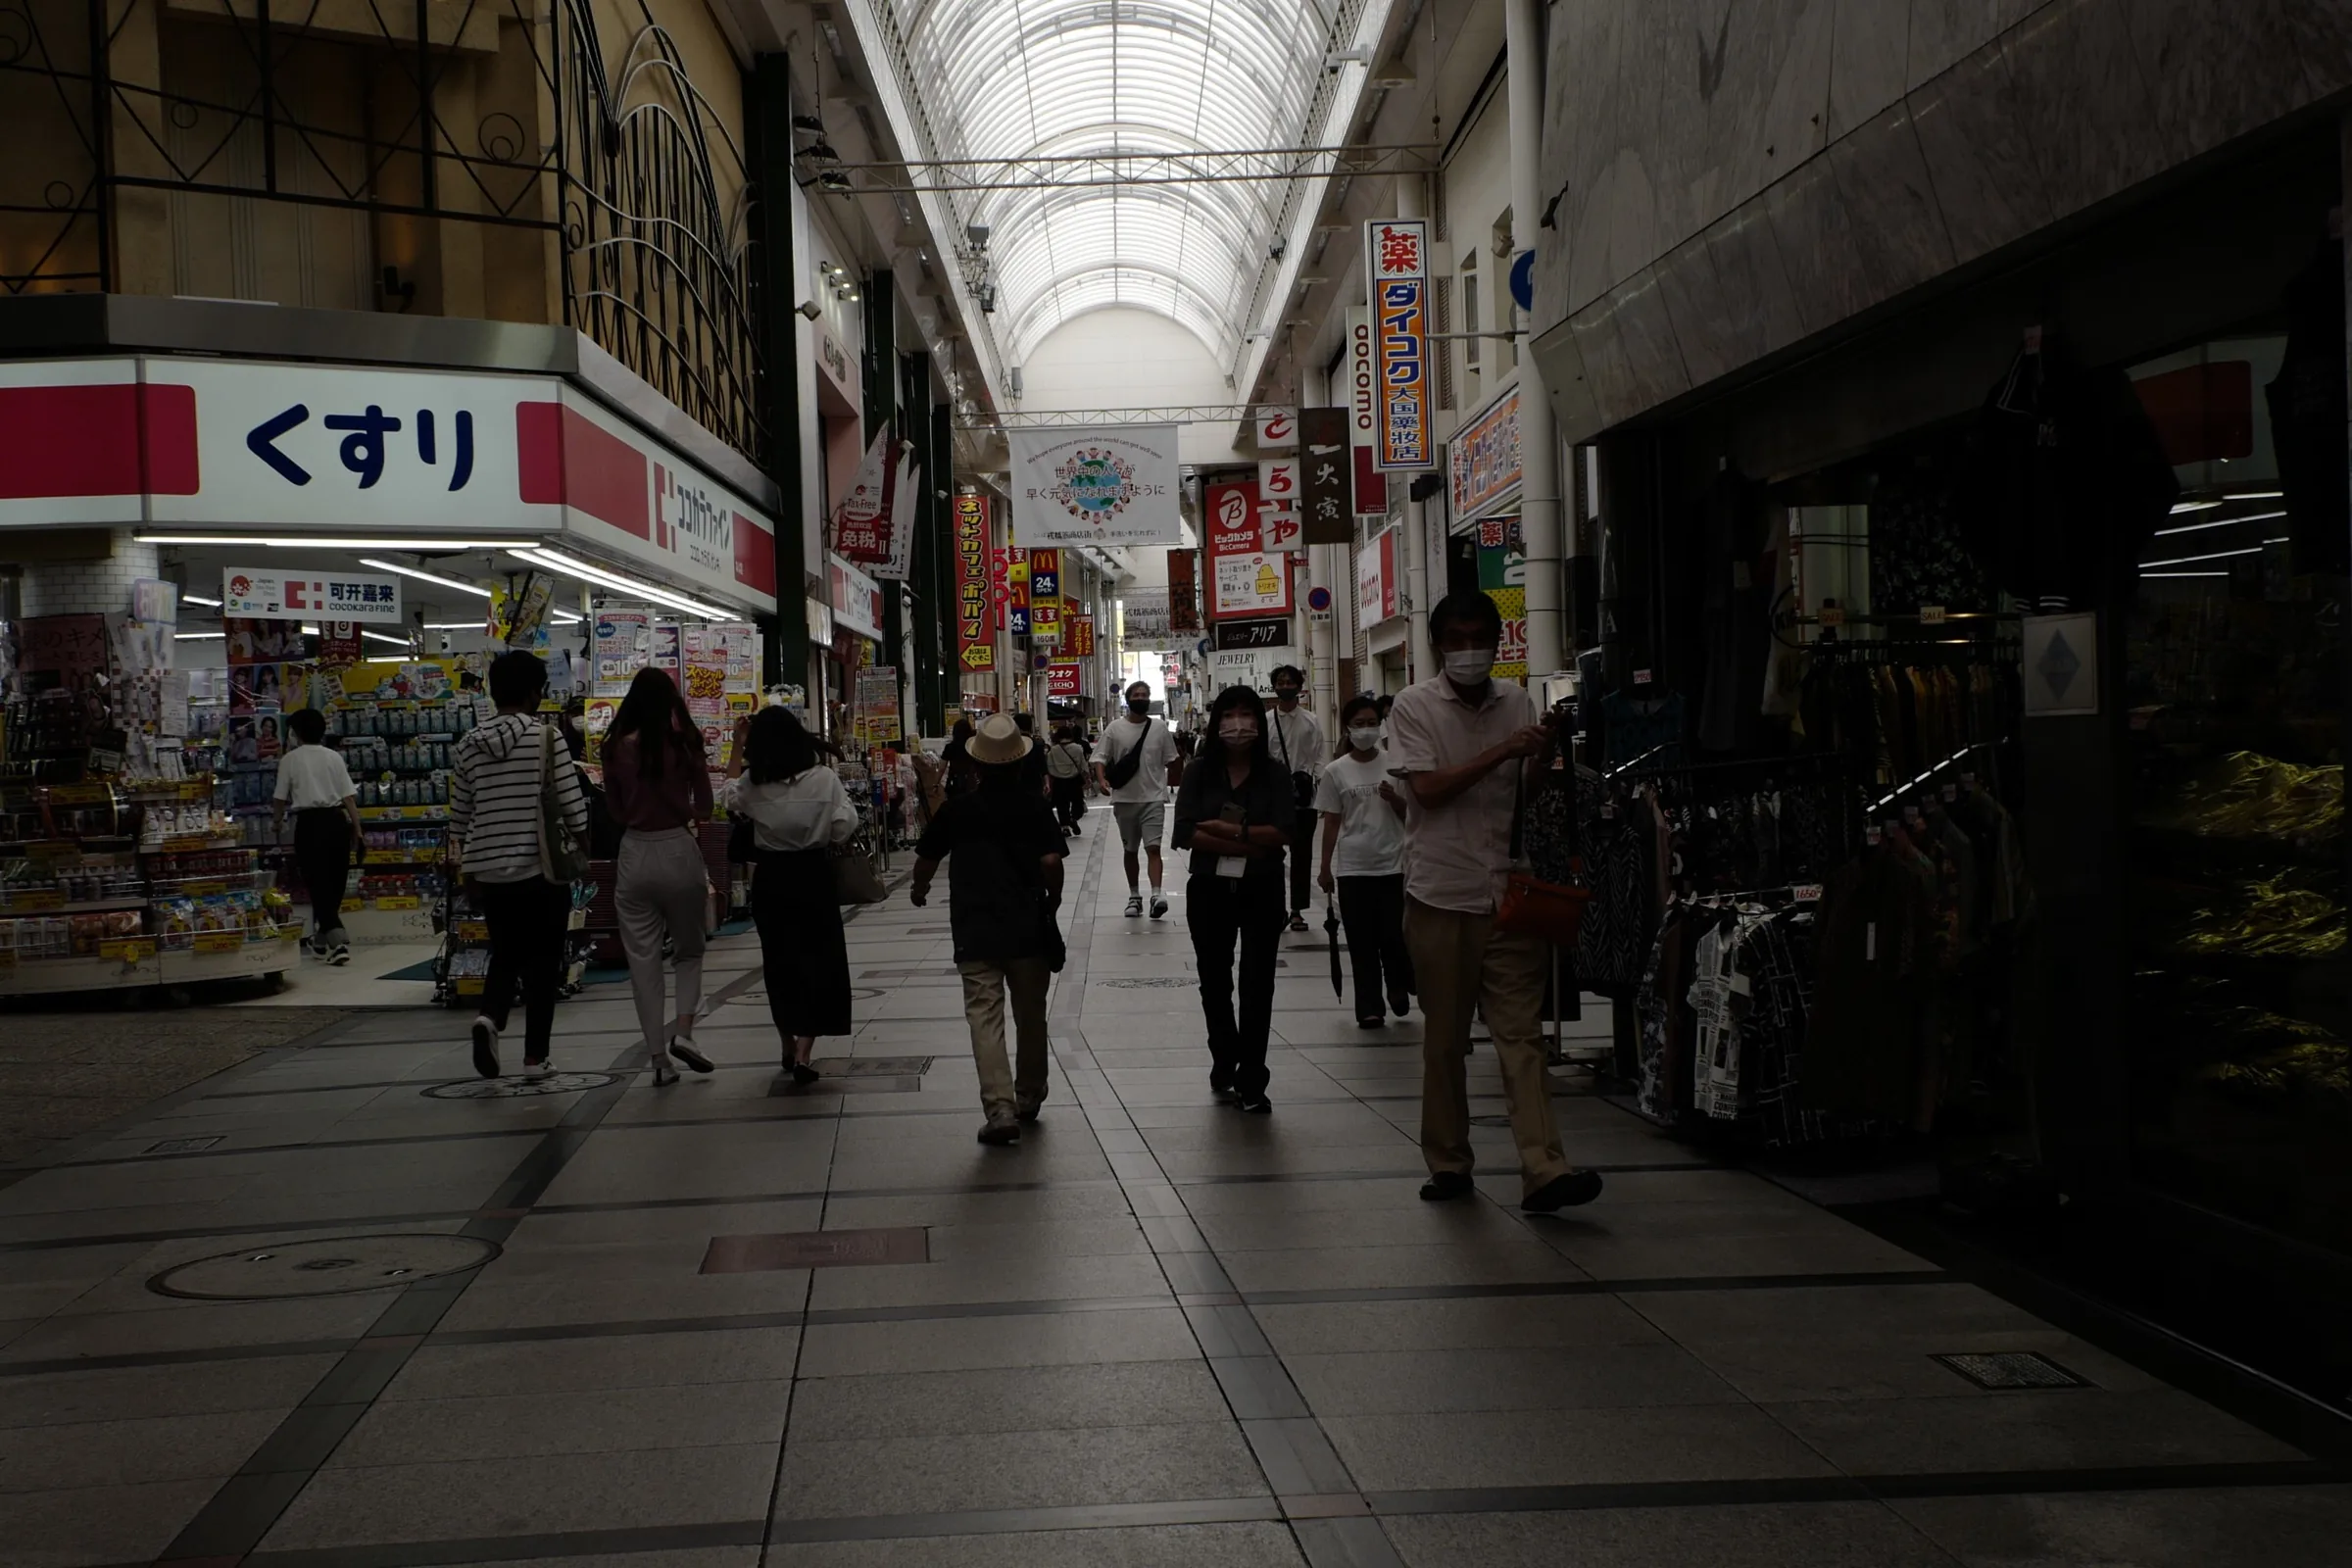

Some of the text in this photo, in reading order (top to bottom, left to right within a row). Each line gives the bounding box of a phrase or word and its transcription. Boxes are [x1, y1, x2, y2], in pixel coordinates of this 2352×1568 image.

[1382, 233, 1418, 273] 薬
[1384, 282, 1419, 384] ダイコク
[246, 404, 474, 491] くすり
[1049, 441, 1072, 452] everyone
[1054, 465, 1136, 478] 世界中の人々が
[1026, 484, 1165, 500] 早く元気になれますように
[848, 499, 877, 510] Tax-Free
[677, 484, 730, 551] ココカラファイン
[841, 530, 876, 549] 免税
[1215, 530, 1254, 544] ビックカメラ
[1219, 543, 1250, 552] BicCamera
[329, 582, 394, 602] 可开嘉来
[1250, 625, 1277, 643] アリア
[1218, 653, 1255, 665] JEWELRY
[686, 664, 725, 681] スペシャル
[1049, 669, 1074, 678] ラオケ
[692, 678, 721, 689] ポイント
